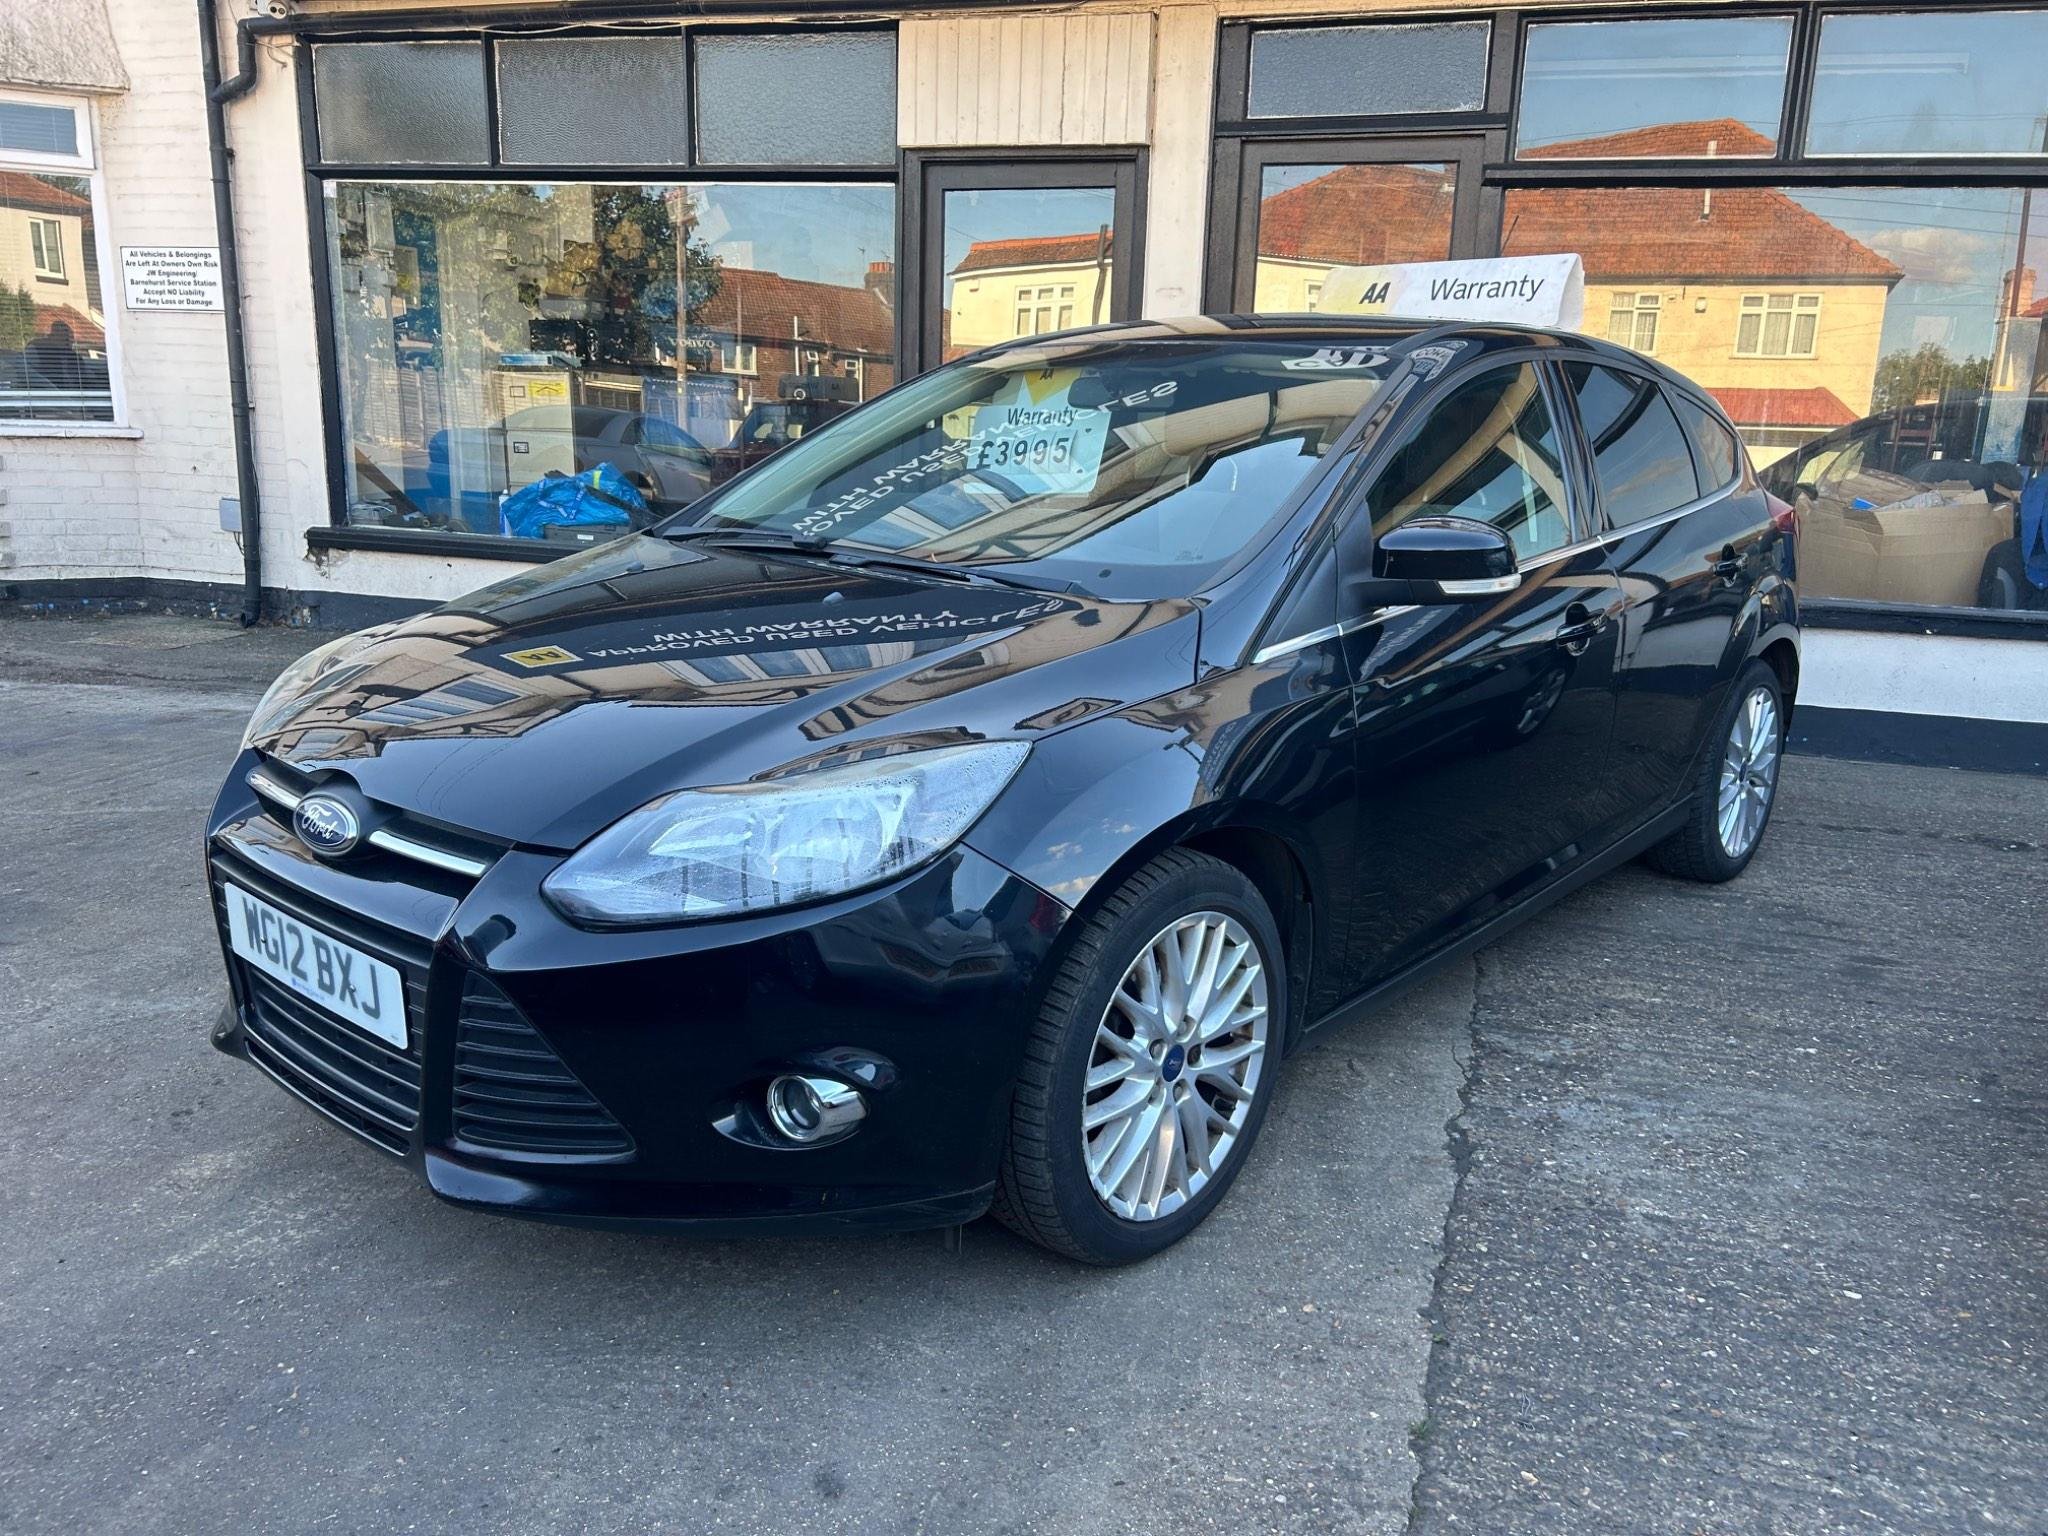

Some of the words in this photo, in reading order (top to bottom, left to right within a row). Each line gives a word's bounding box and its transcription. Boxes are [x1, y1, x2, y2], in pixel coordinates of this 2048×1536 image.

[129, 250, 138, 258] All
[140, 250, 167, 258] Vehicles
[175, 251, 212, 259] Belongings
[143, 288, 166, 297] Accept
[179, 289, 205, 298] Liability
[167, 279, 192, 287] Service
[1359, 281, 1391, 305] AA
[1430, 274, 1545, 302] Warranty
[147, 298, 160, 306] Any
[186, 298, 213, 307] Damage
[1008, 405, 1078, 428] Warranty
[976, 437, 1070, 470] £3995
[301, 805, 343, 840] Ford
[242, 896, 308, 982] WG12
[312, 936, 381, 1020] BXJ
